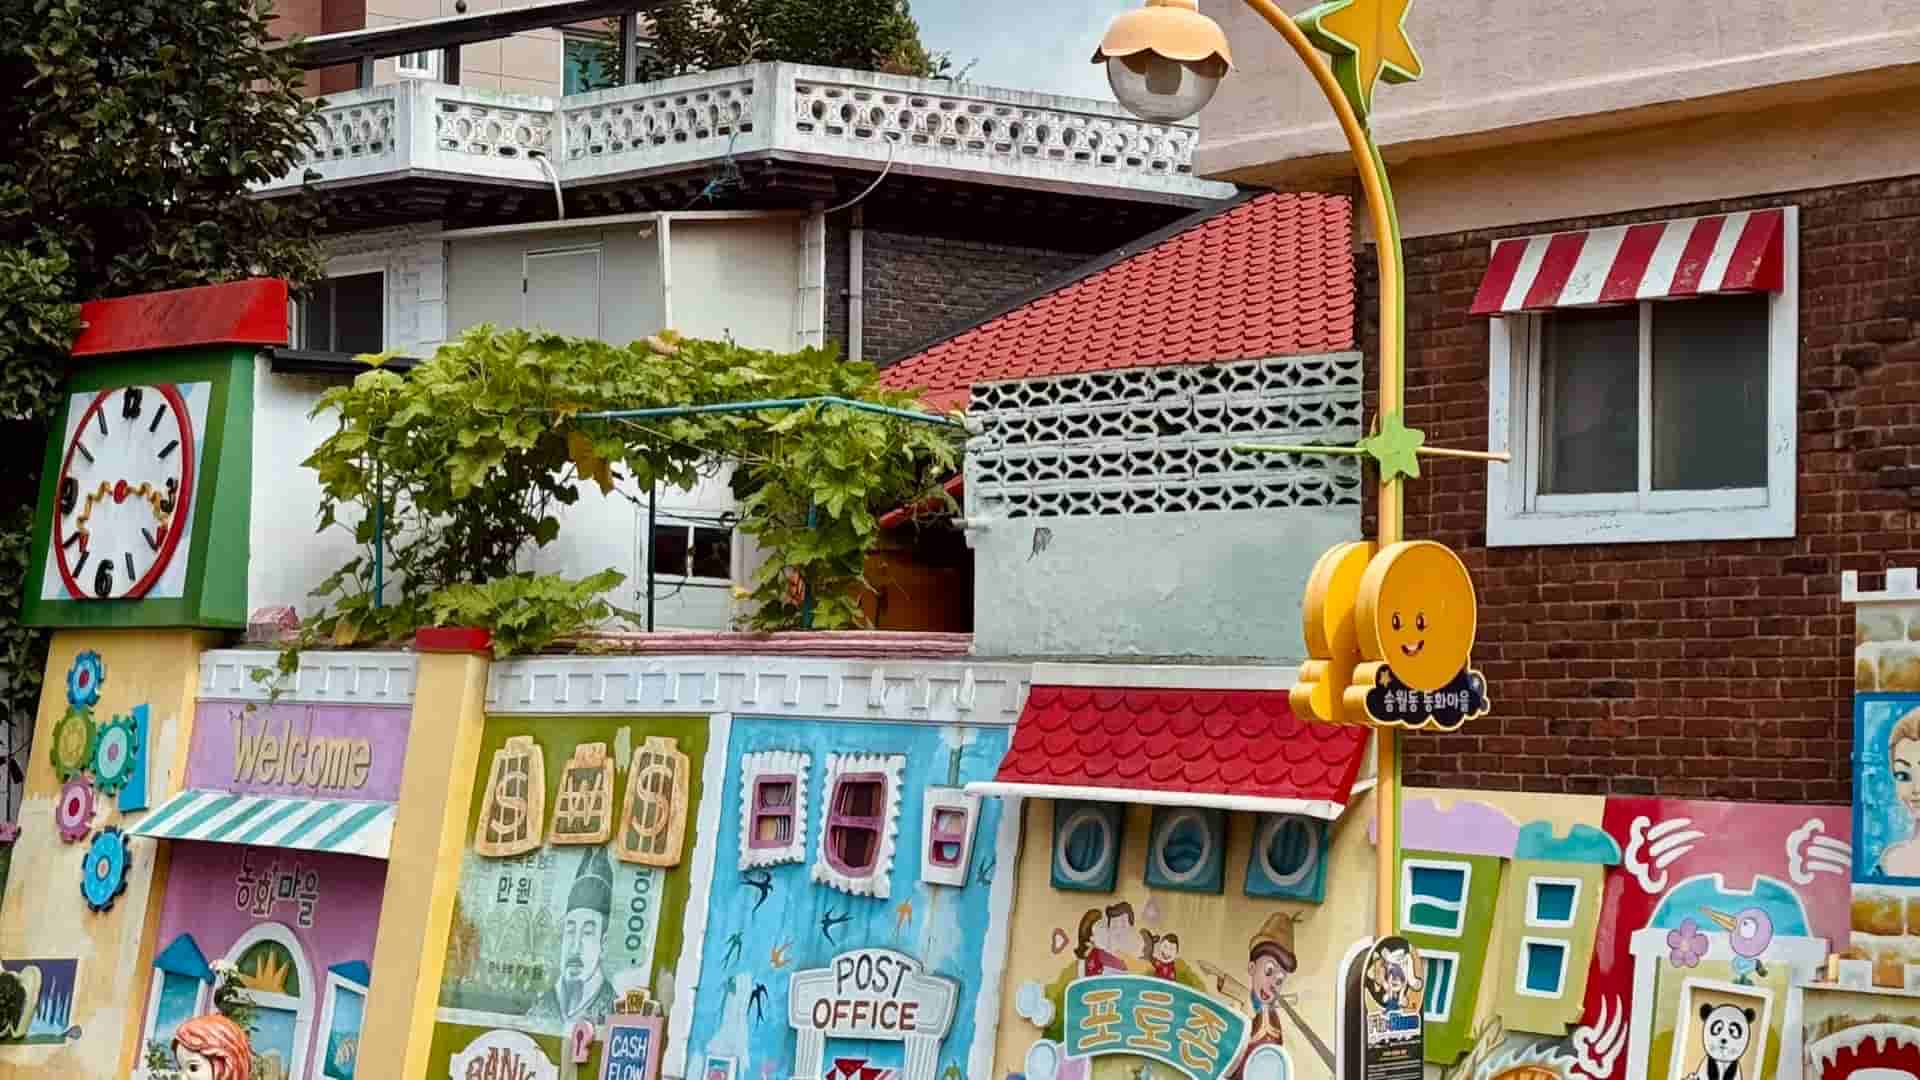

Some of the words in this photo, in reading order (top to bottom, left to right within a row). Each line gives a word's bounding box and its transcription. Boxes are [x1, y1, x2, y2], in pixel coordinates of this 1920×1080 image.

[61, 477, 79, 515] 9
[160, 477, 178, 513] 3
[94, 559, 114, 597] 6
[1383, 689, 1419, 713] 송월동
[1423, 689, 1470, 713] 동화마을
[232, 713, 373, 790] Welcome
[836, 954, 913, 998] POST
[812, 998, 920, 1031] OFFICE
[1078, 987, 1229, 1075] 포토존
[611, 1035, 648, 1058] CASH
